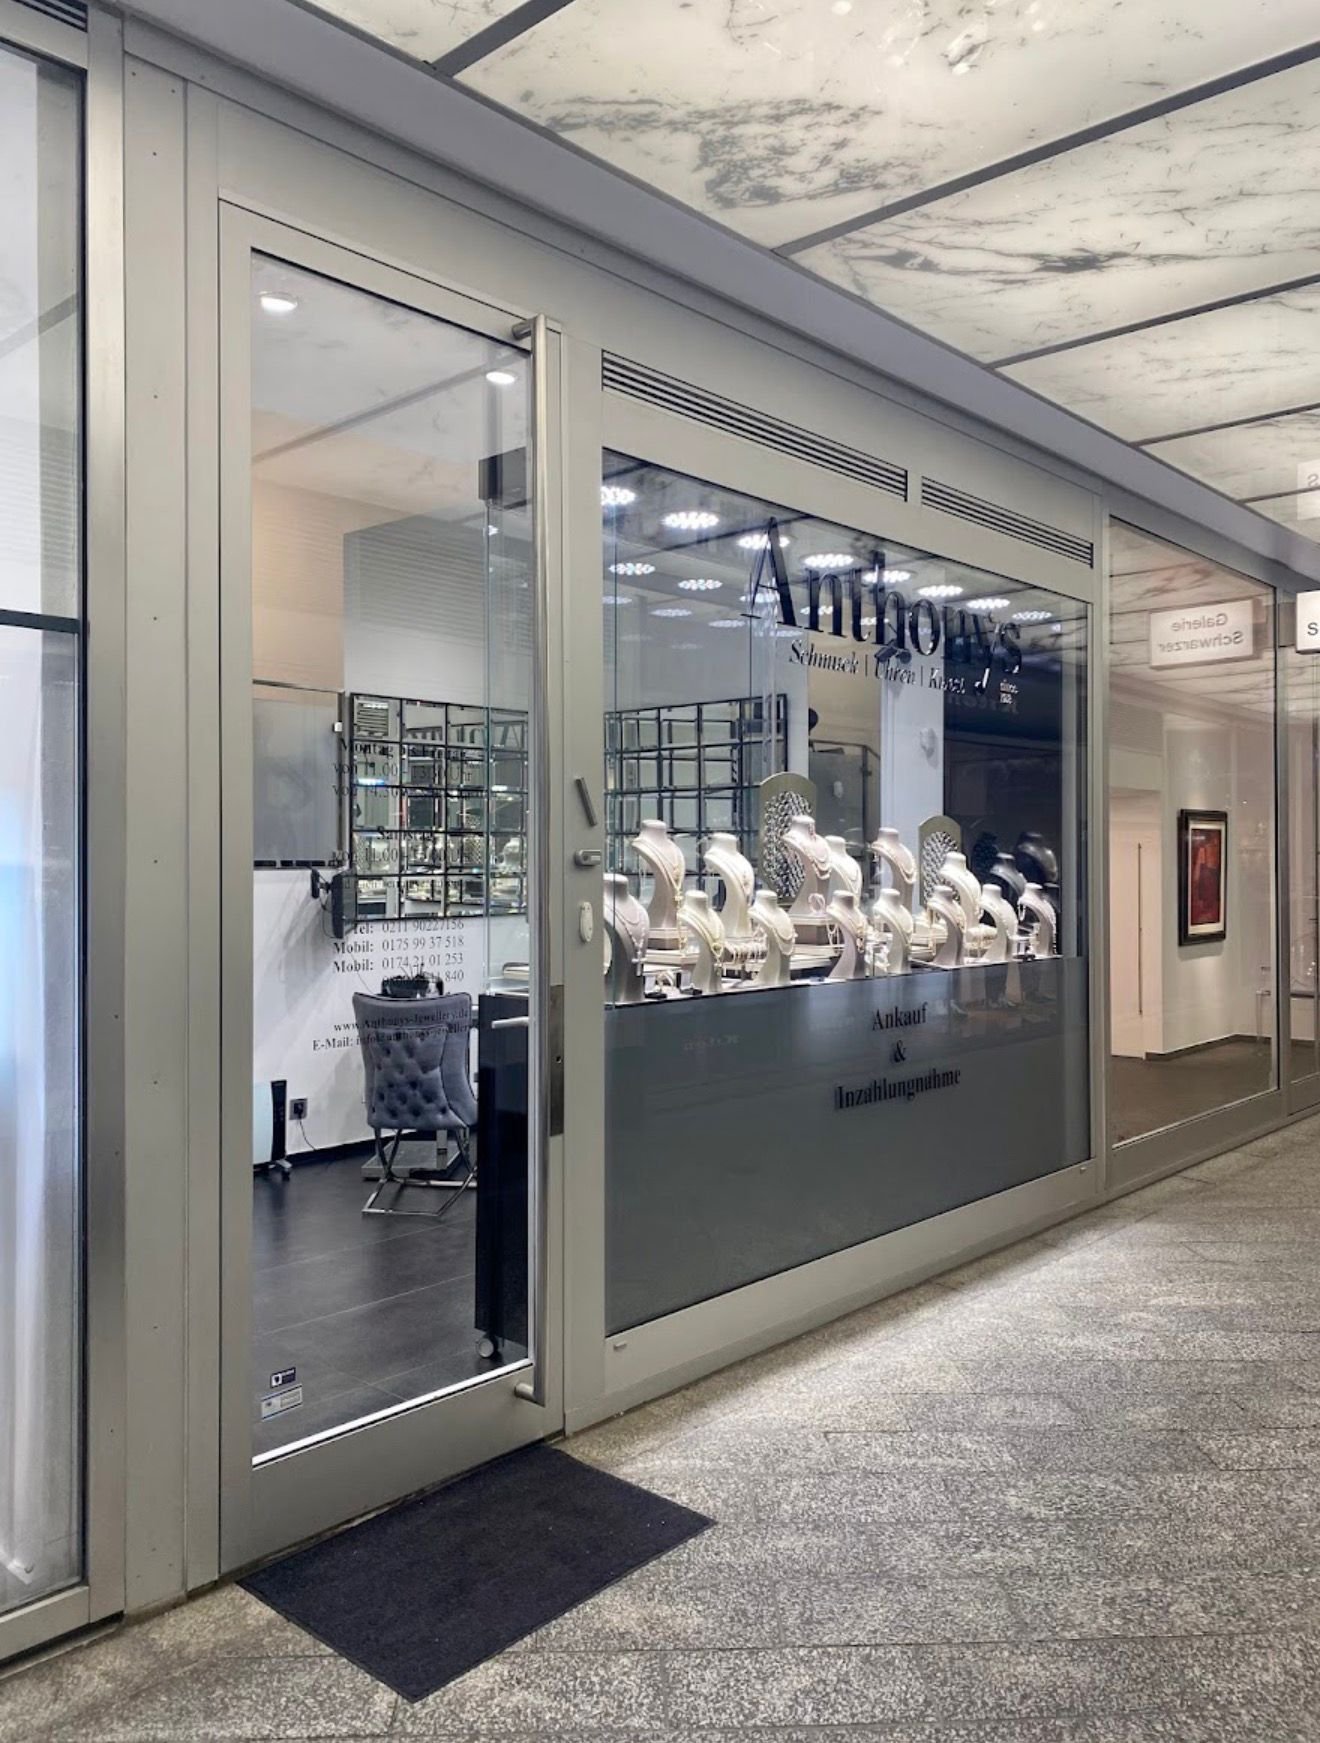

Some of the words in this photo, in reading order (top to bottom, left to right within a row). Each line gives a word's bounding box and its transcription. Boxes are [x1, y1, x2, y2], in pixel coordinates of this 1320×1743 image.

[789, 639, 859, 675] Schmuck
[333, 941, 375, 955] Mobil:
[382, 938, 409, 953] 0175
[413, 937, 426, 951] 99
[429, 936, 442, 950] 37
[445, 934, 464, 948] 518
[333, 959, 375, 973] Mobil:
[382, 956, 409, 970] 0174
[429, 954, 441, 967] 01
[445, 952, 464, 966] 253
[445, 969, 465, 983] 840
[872, 1002, 928, 1031] Ankauf
[312, 1036, 354, 1052] E-Mail:
[893, 1040, 906, 1062] &
[836, 1068, 961, 1109] Inzahlungnahme
